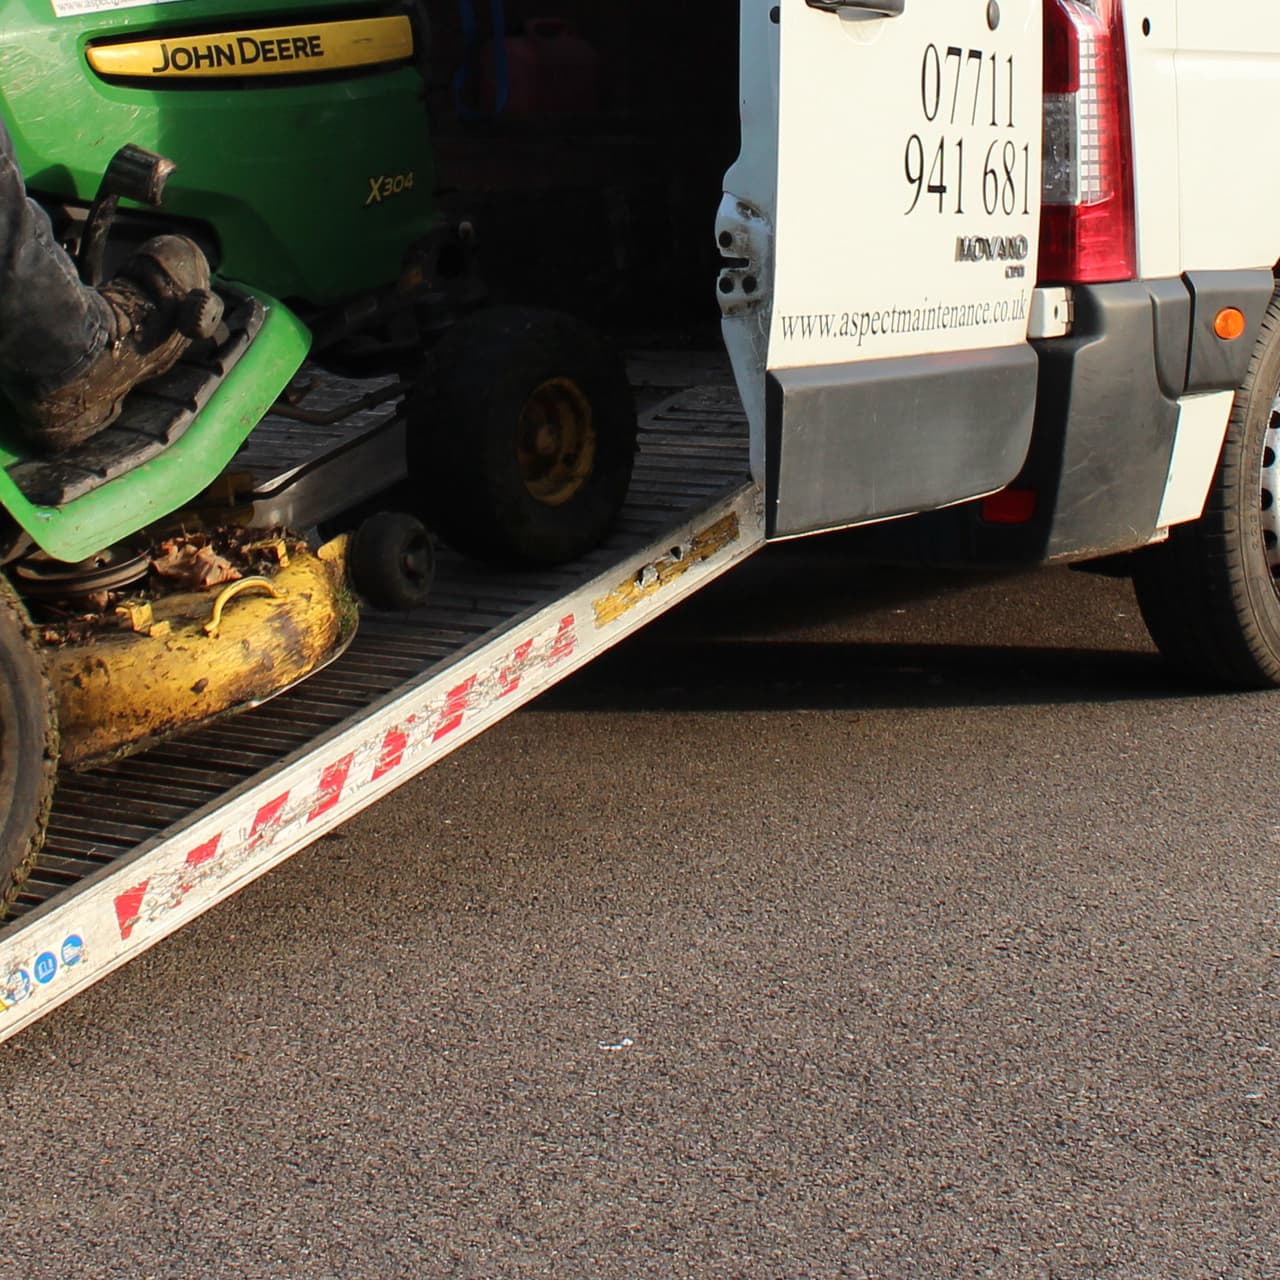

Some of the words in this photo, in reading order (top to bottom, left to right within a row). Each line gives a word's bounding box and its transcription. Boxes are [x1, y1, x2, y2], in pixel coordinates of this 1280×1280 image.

[152, 41, 236, 73] JOHN
[237, 35, 325, 65] DEERE
[921, 42, 1016, 128] 07711
[365, 170, 415, 206] X304
[904, 133, 965, 216] 941
[982, 139, 1031, 216] 681
[954, 233, 1029, 262] MOVANO
[780, 289, 1028, 347] www.aspectmaintenance.co.uk
